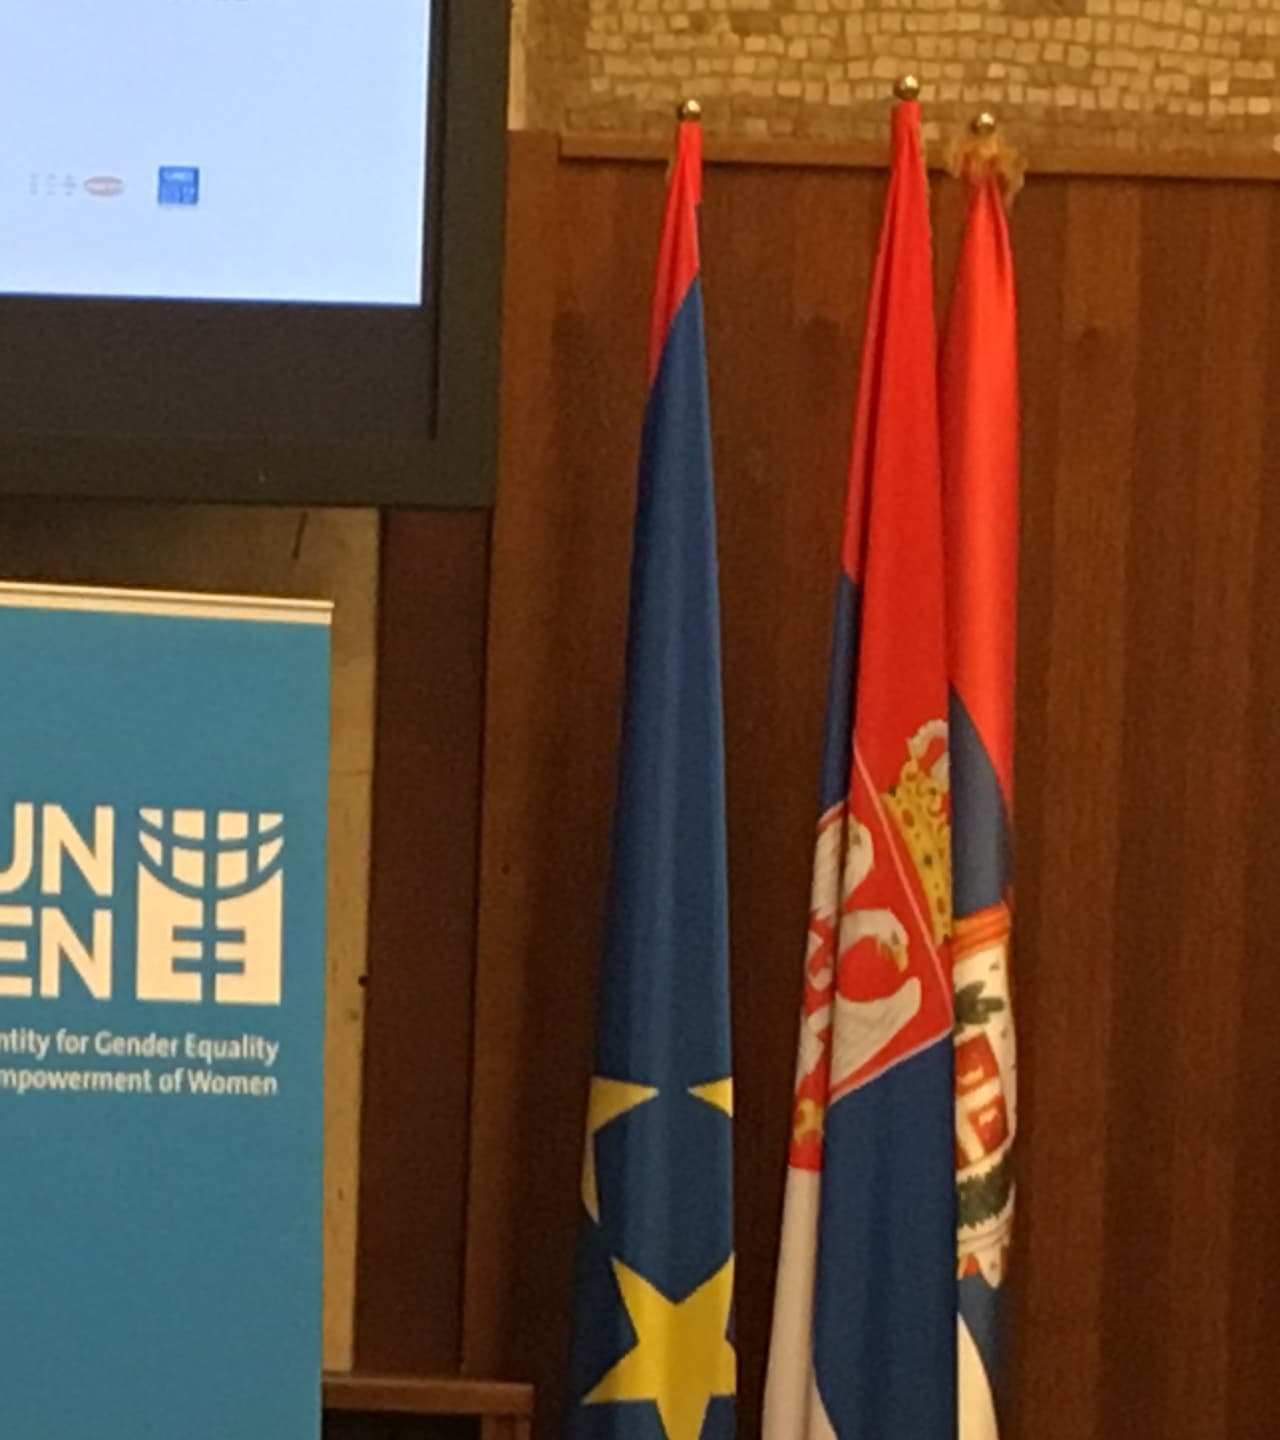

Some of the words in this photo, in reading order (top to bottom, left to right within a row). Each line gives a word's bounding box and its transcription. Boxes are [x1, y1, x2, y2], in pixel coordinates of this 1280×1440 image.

[56, 1028, 90, 1054] for
[95, 1030, 178, 1058] Gender
[185, 1033, 279, 1067] Equality
[159, 1066, 185, 1093] of
[187, 1068, 278, 1096] Women
